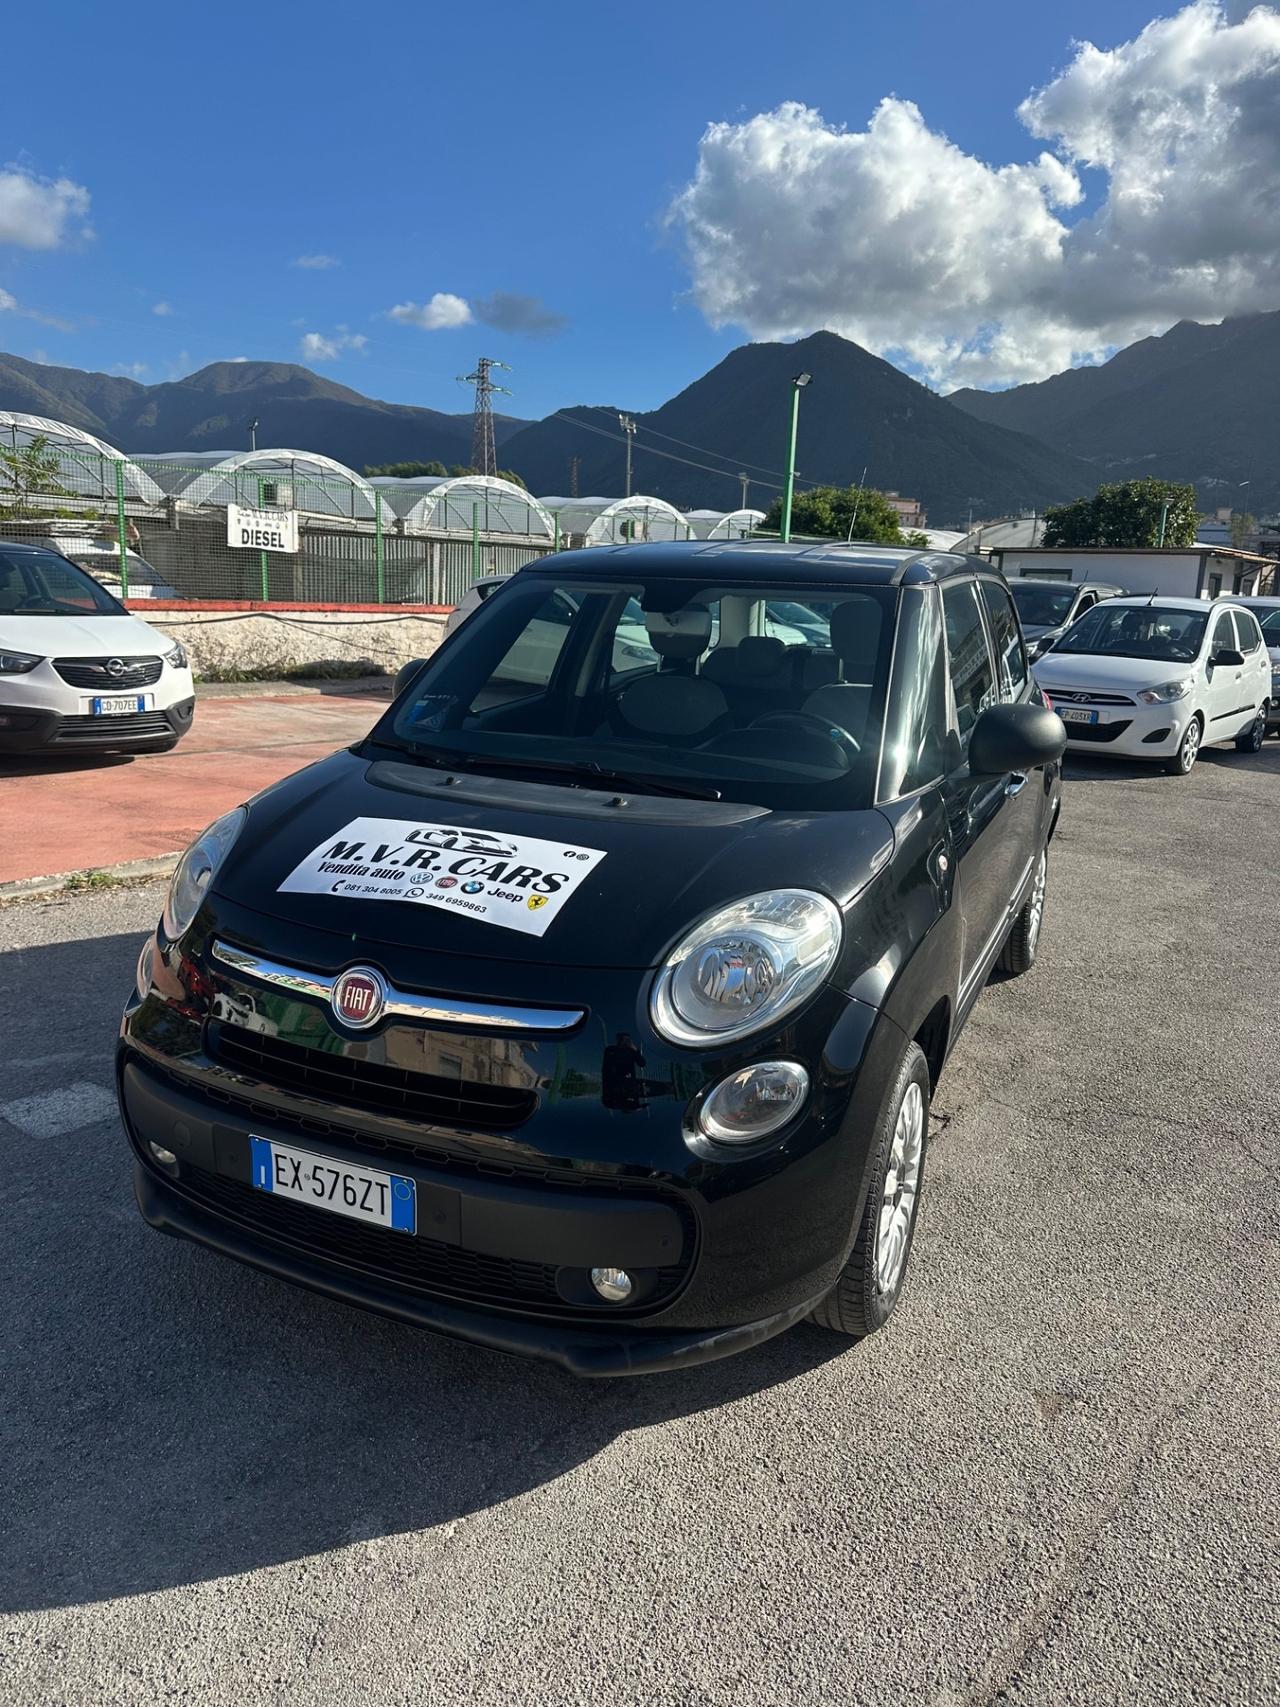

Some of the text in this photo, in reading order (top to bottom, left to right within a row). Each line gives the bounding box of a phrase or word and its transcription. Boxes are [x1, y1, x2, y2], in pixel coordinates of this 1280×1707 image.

[241, 528, 285, 549] DIESEL
[317, 862, 406, 880] Vendita auto
[344, 883, 362, 892] 081
[487, 888, 524, 903] Jeep
[425, 892, 445, 901] 349
[343, 985, 372, 1011] FIAT
